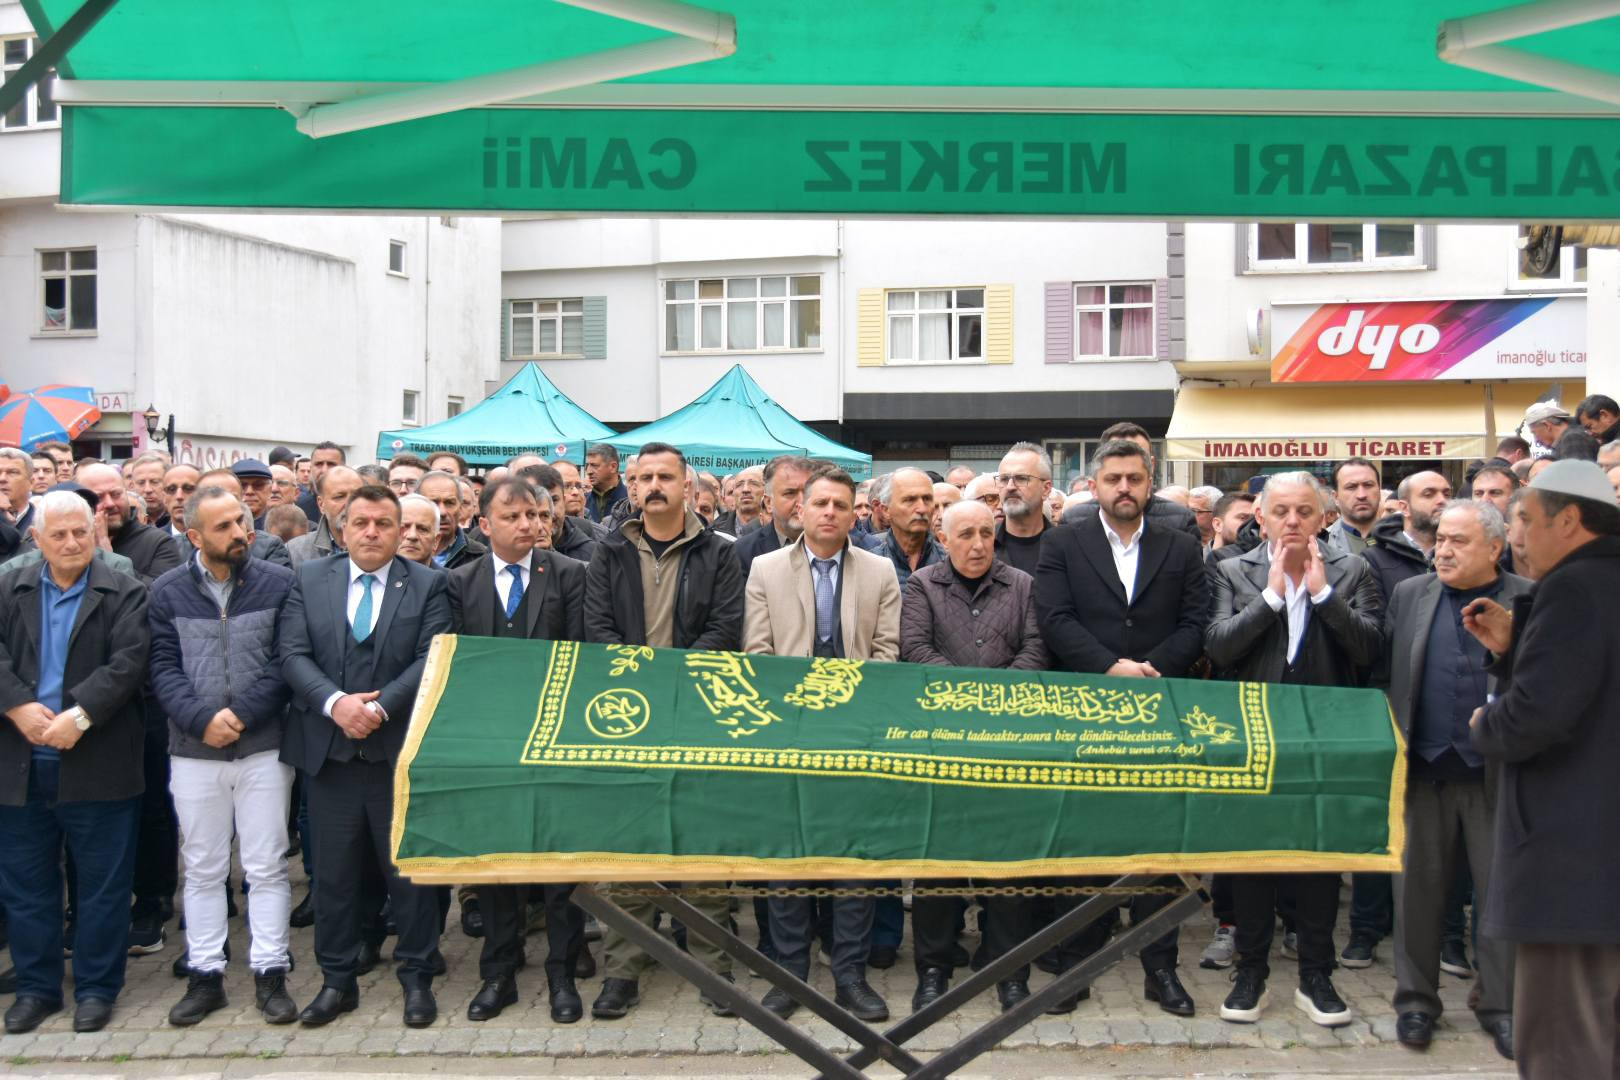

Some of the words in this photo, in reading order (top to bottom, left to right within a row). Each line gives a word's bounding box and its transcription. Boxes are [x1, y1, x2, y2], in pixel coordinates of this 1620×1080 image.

[1317, 310, 1440, 369] dyo
[1496, 350, 1556, 366] imanoğlu
[410, 443, 447, 453] TRABZON
[1204, 439, 1328, 457] İMANOĞLU
[1346, 438, 1446, 456] TİCARET
[686, 454, 714, 467] AİRESİ
[885, 727, 908, 739] Her
[910, 729, 928, 739] can
[1055, 729, 1076, 742] bize
